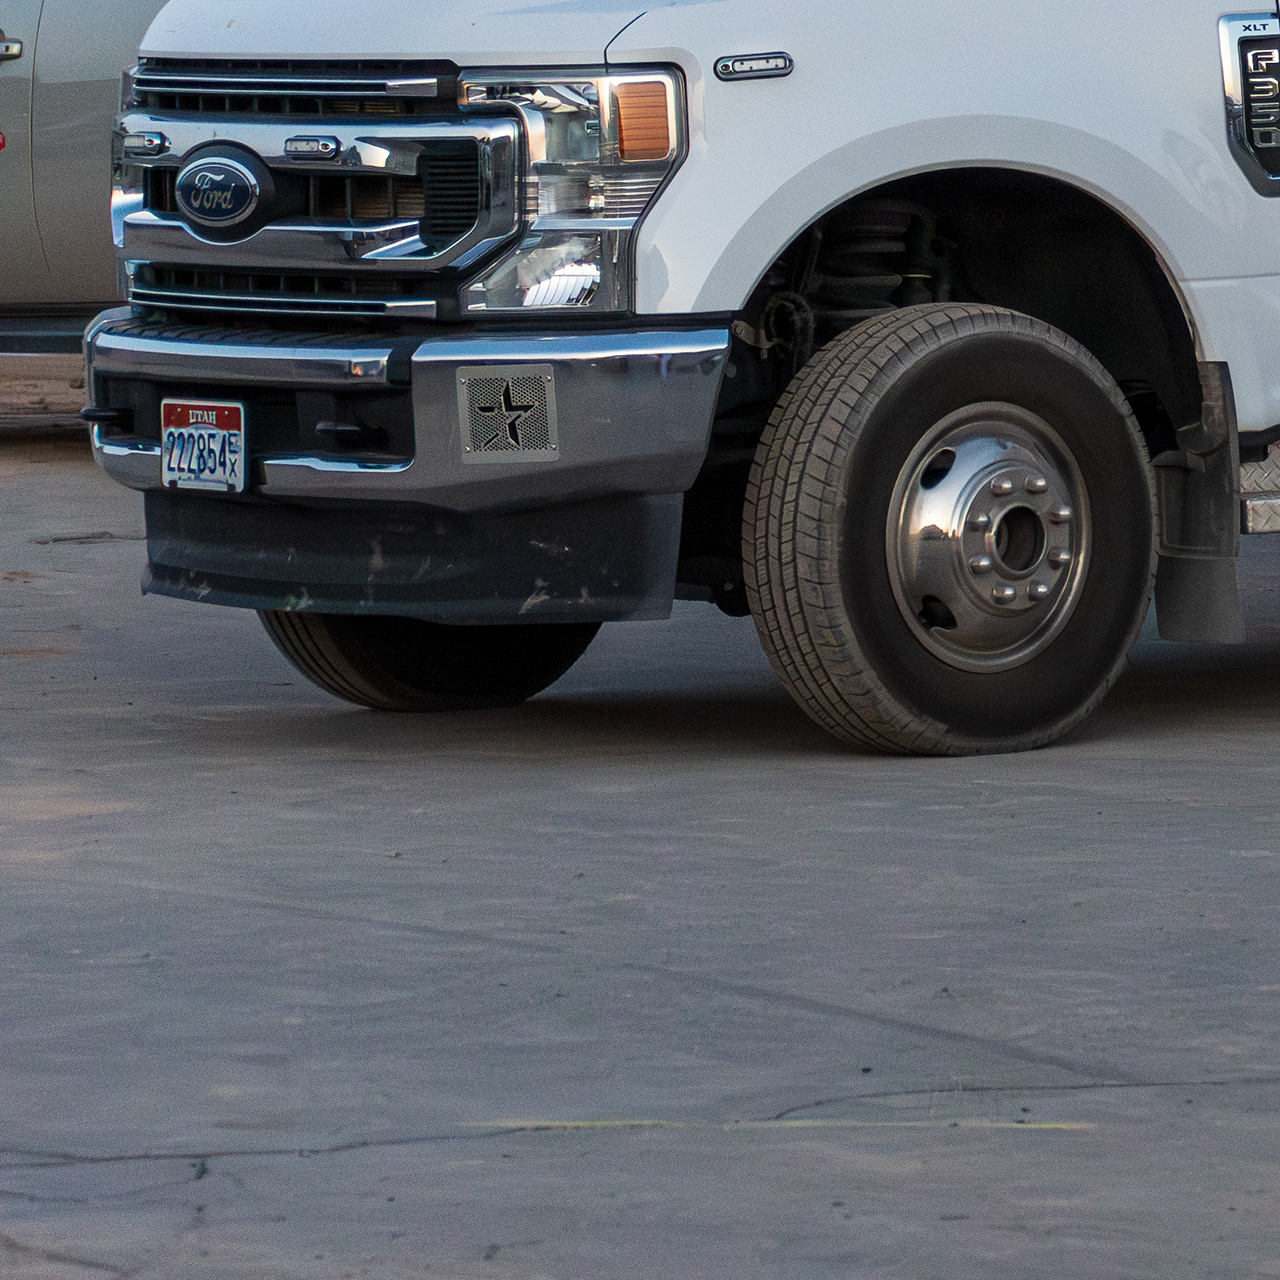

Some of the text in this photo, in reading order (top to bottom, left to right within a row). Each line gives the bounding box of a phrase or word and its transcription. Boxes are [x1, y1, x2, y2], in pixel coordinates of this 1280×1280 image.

[1242, 23, 1270, 32] XLT
[190, 171, 235, 210] Ford
[188, 409, 217, 425] UTAH
[167, 430, 227, 476] 222854
